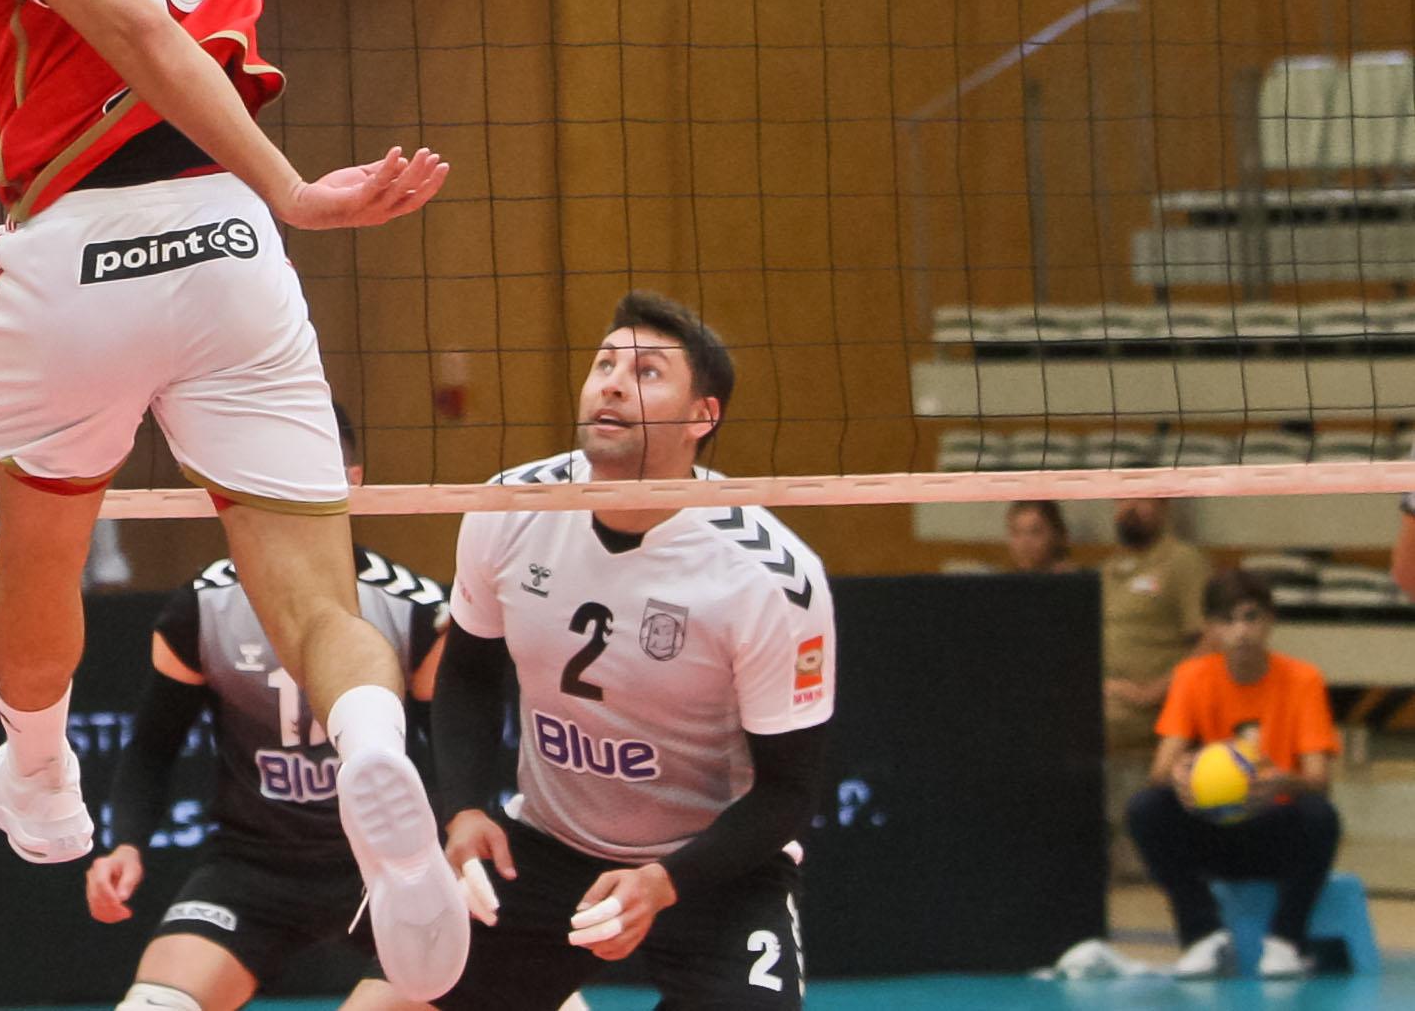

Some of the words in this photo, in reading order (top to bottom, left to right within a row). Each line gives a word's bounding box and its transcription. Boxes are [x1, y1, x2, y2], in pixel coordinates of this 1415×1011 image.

[94, 229, 205, 279] point
[560, 601, 614, 702] 2
[255, 749, 336, 803] Blu
[532, 708, 660, 783] Blue
[746, 929, 783, 992] 2
